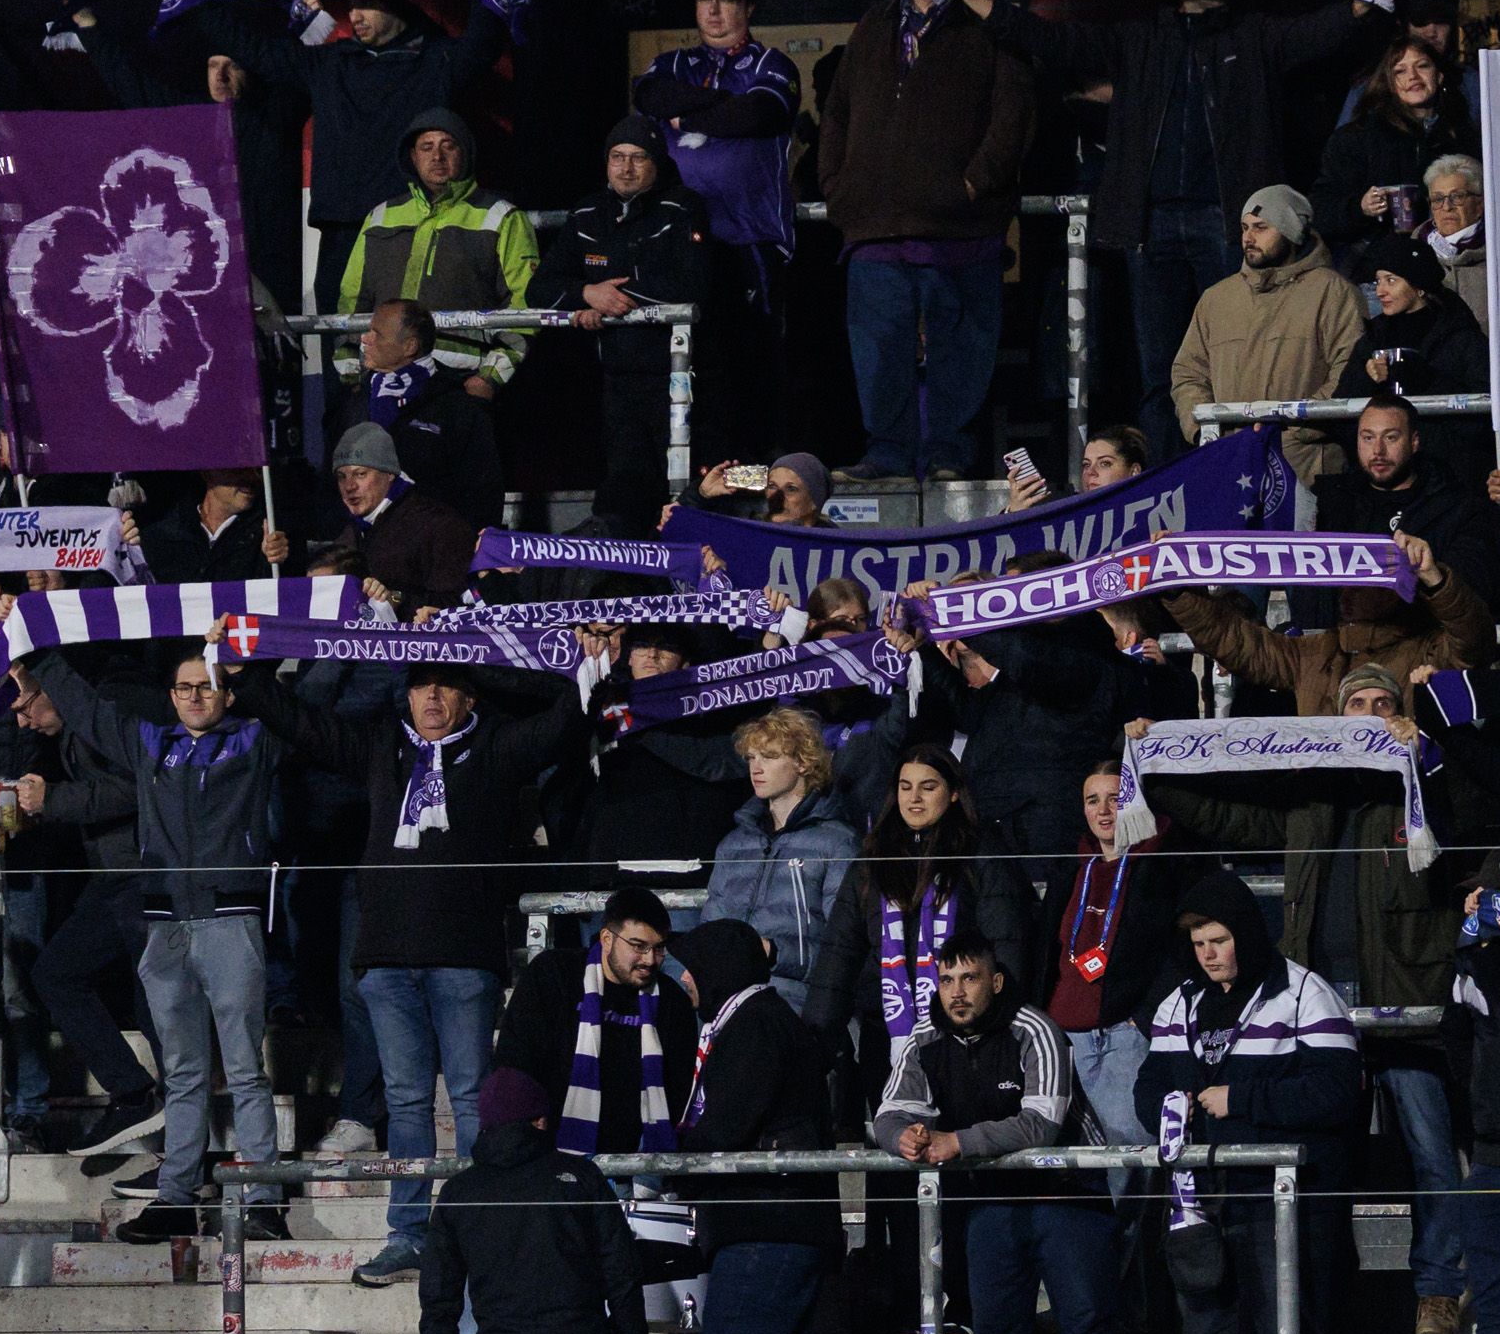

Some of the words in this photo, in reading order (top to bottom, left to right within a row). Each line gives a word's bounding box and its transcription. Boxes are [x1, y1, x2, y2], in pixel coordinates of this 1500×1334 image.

[14, 528, 101, 548] JUVENTUS
[934, 570, 1087, 626] HOCH
[1151, 541, 1383, 581] AUSTRIA
[314, 638, 490, 665] DONAUSTADT
[696, 646, 798, 685] SEKTION
[680, 667, 834, 718] DONAUSTADT
[1224, 734, 1343, 759] Austria
